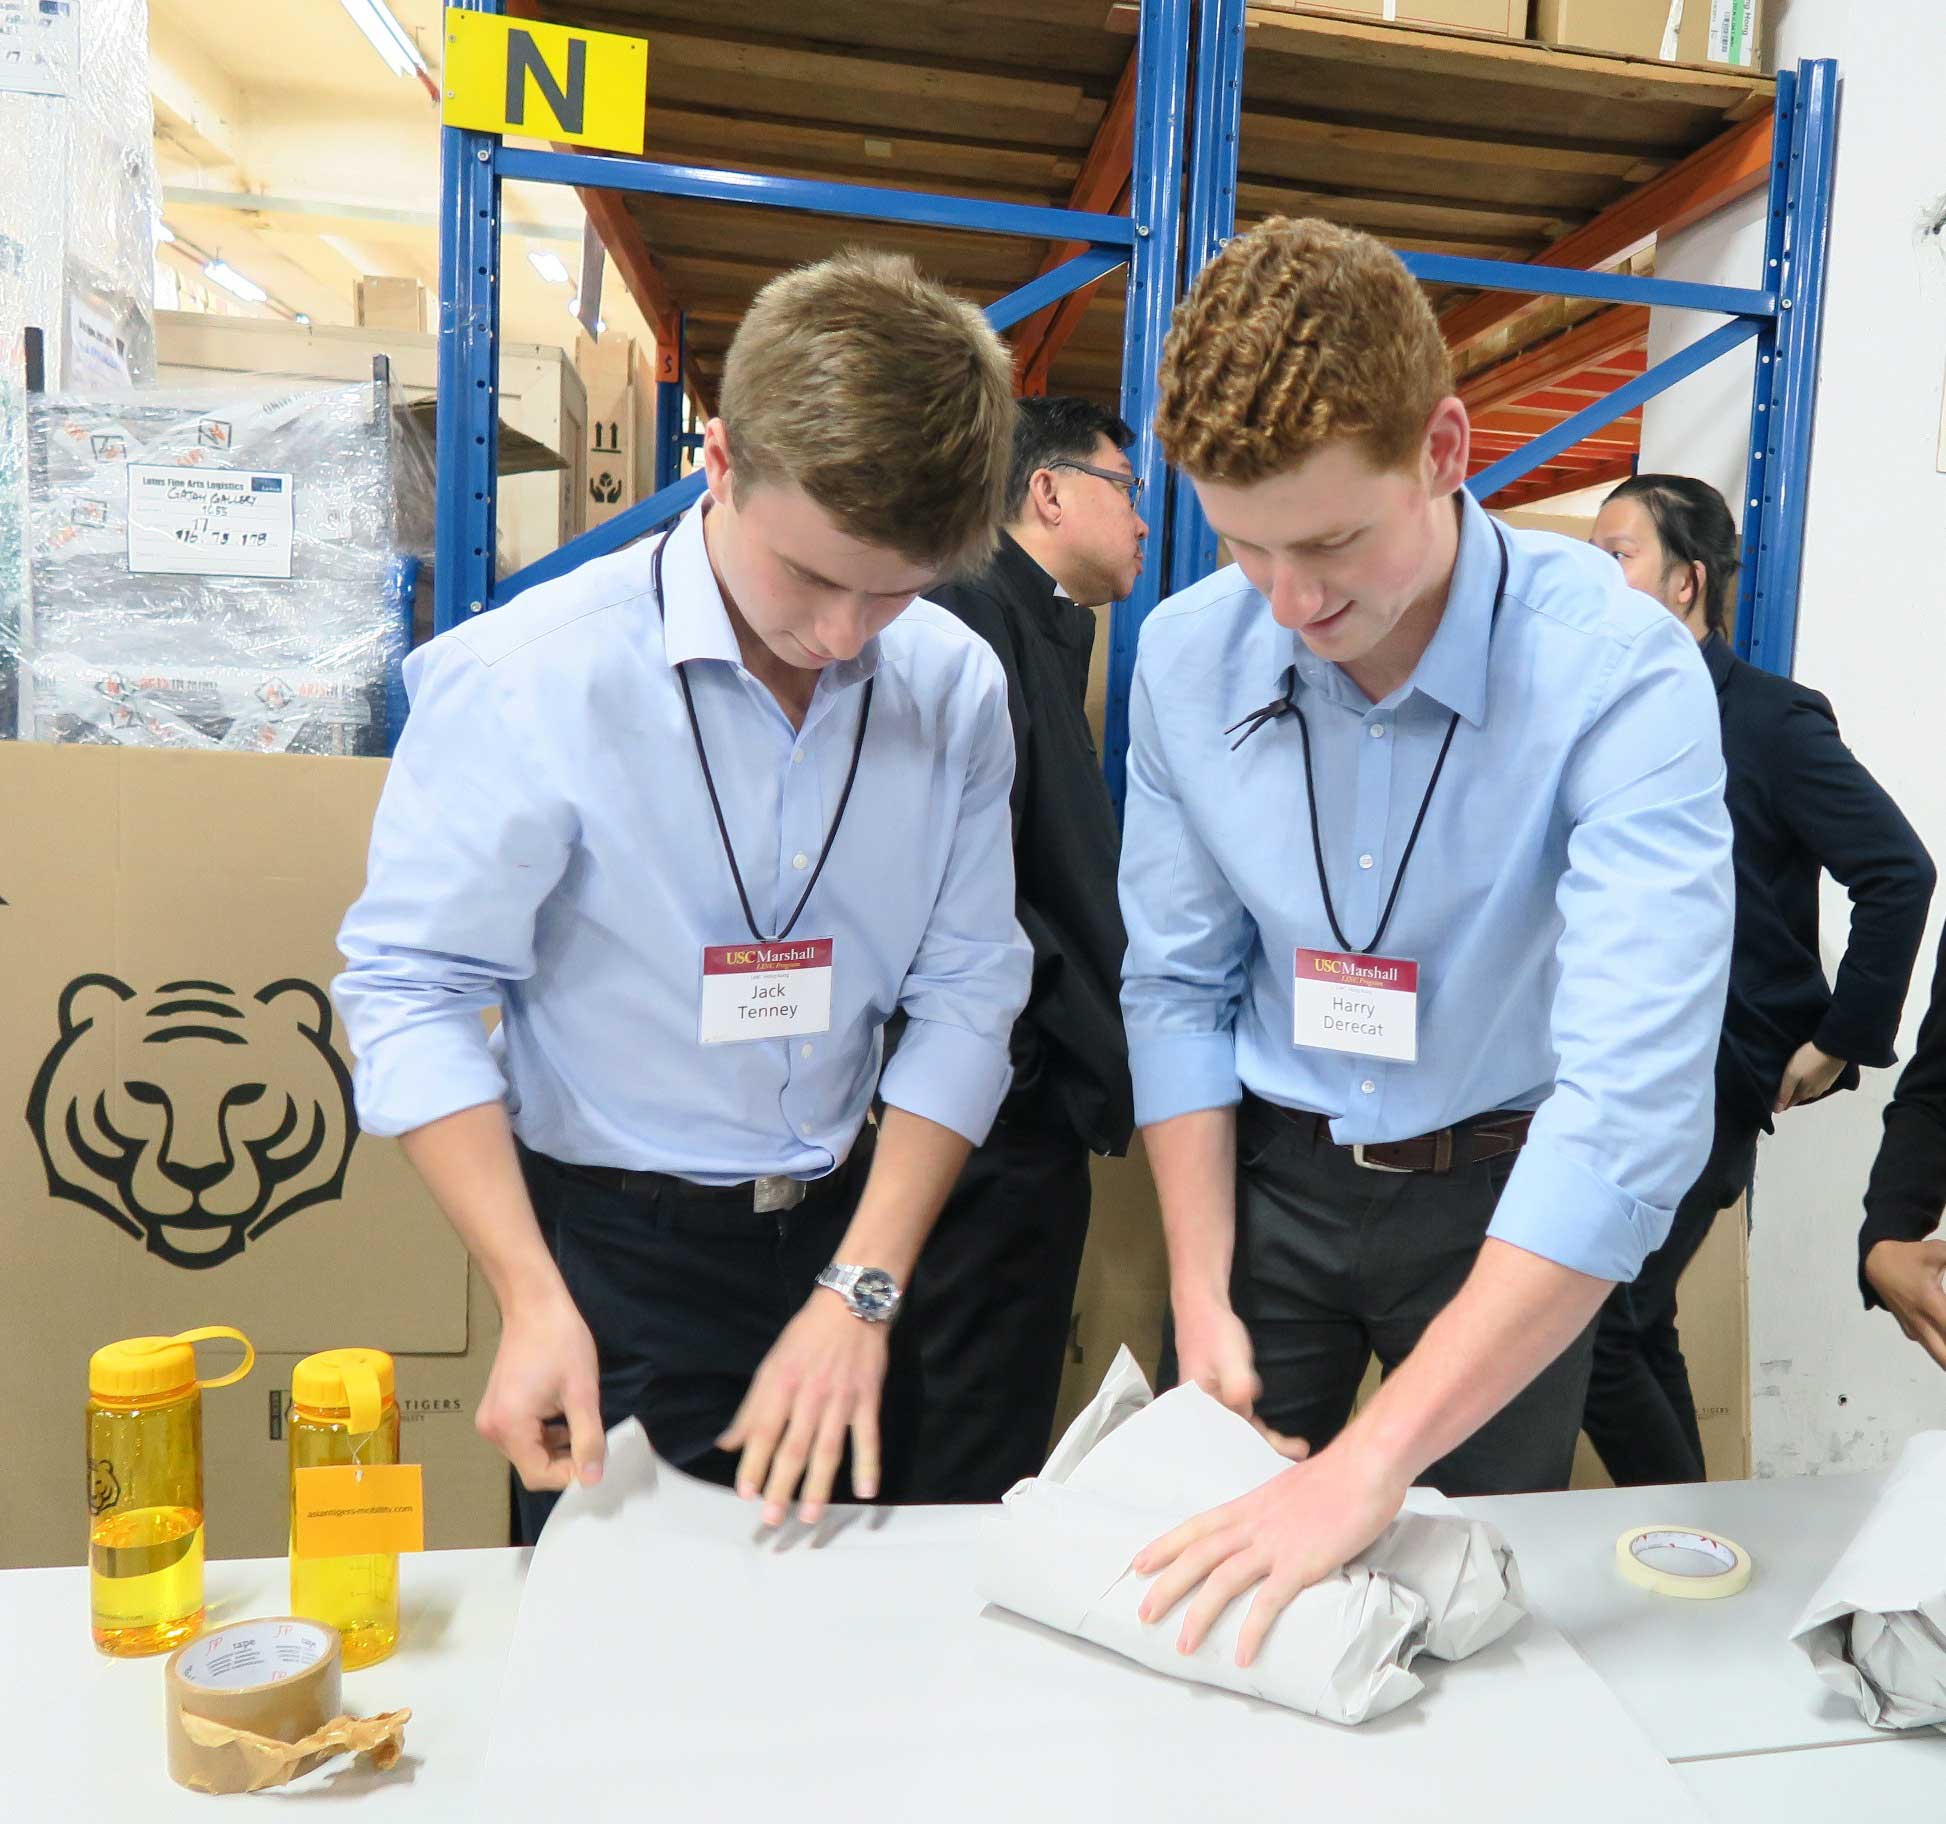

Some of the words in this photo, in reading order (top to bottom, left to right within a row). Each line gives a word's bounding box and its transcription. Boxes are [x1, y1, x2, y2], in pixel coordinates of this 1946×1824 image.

[505, 28, 586, 135] N
[168, 478, 185, 487] Fine
[187, 479, 205, 489] Arts
[207, 481, 244, 491] Logistics
[752, 983, 786, 999] Jack
[738, 1004, 798, 1020] Tenney
[1332, 996, 1375, 1018] Harry
[1323, 1015, 1384, 1037] Derecat
[404, 1399, 461, 1410] TIGERS
[232, 1638, 257, 1650] tape
